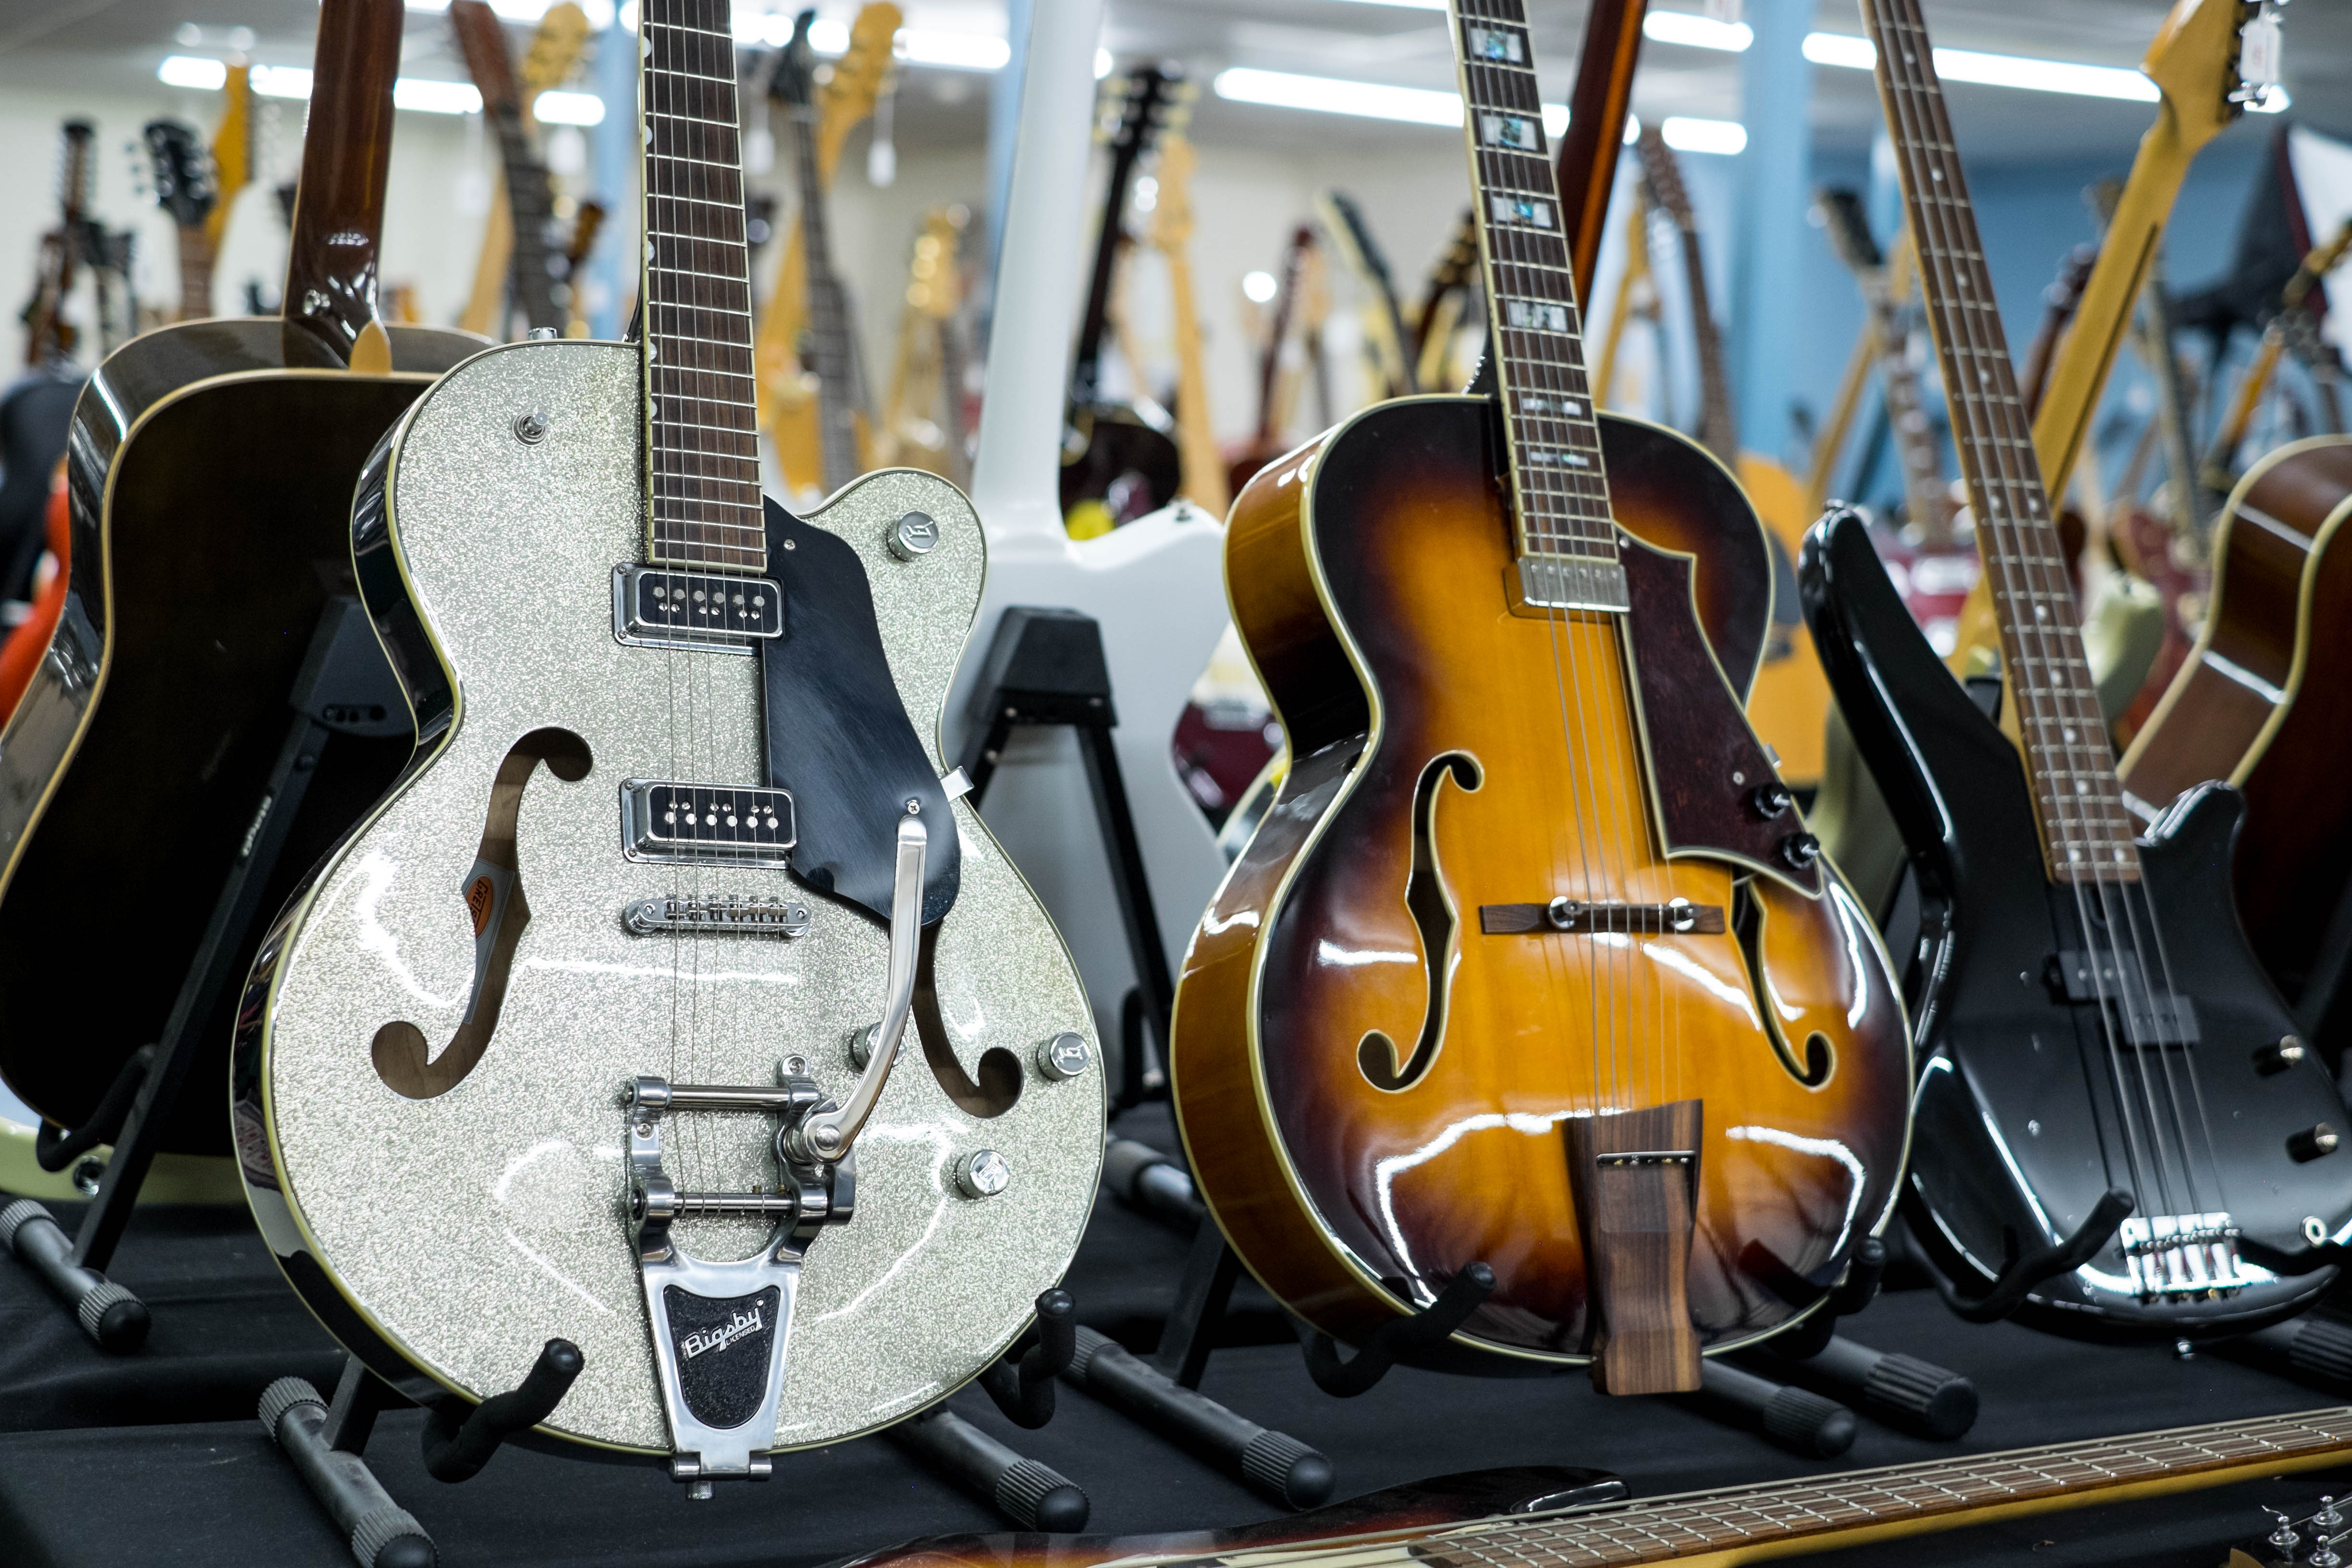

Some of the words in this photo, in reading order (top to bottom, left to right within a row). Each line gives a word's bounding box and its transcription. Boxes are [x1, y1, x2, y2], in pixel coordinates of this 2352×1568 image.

[470, 879, 489, 927] GRETS
[685, 1307, 763, 1359] Bigsby
[725, 1325, 755, 1346] LICENSED
